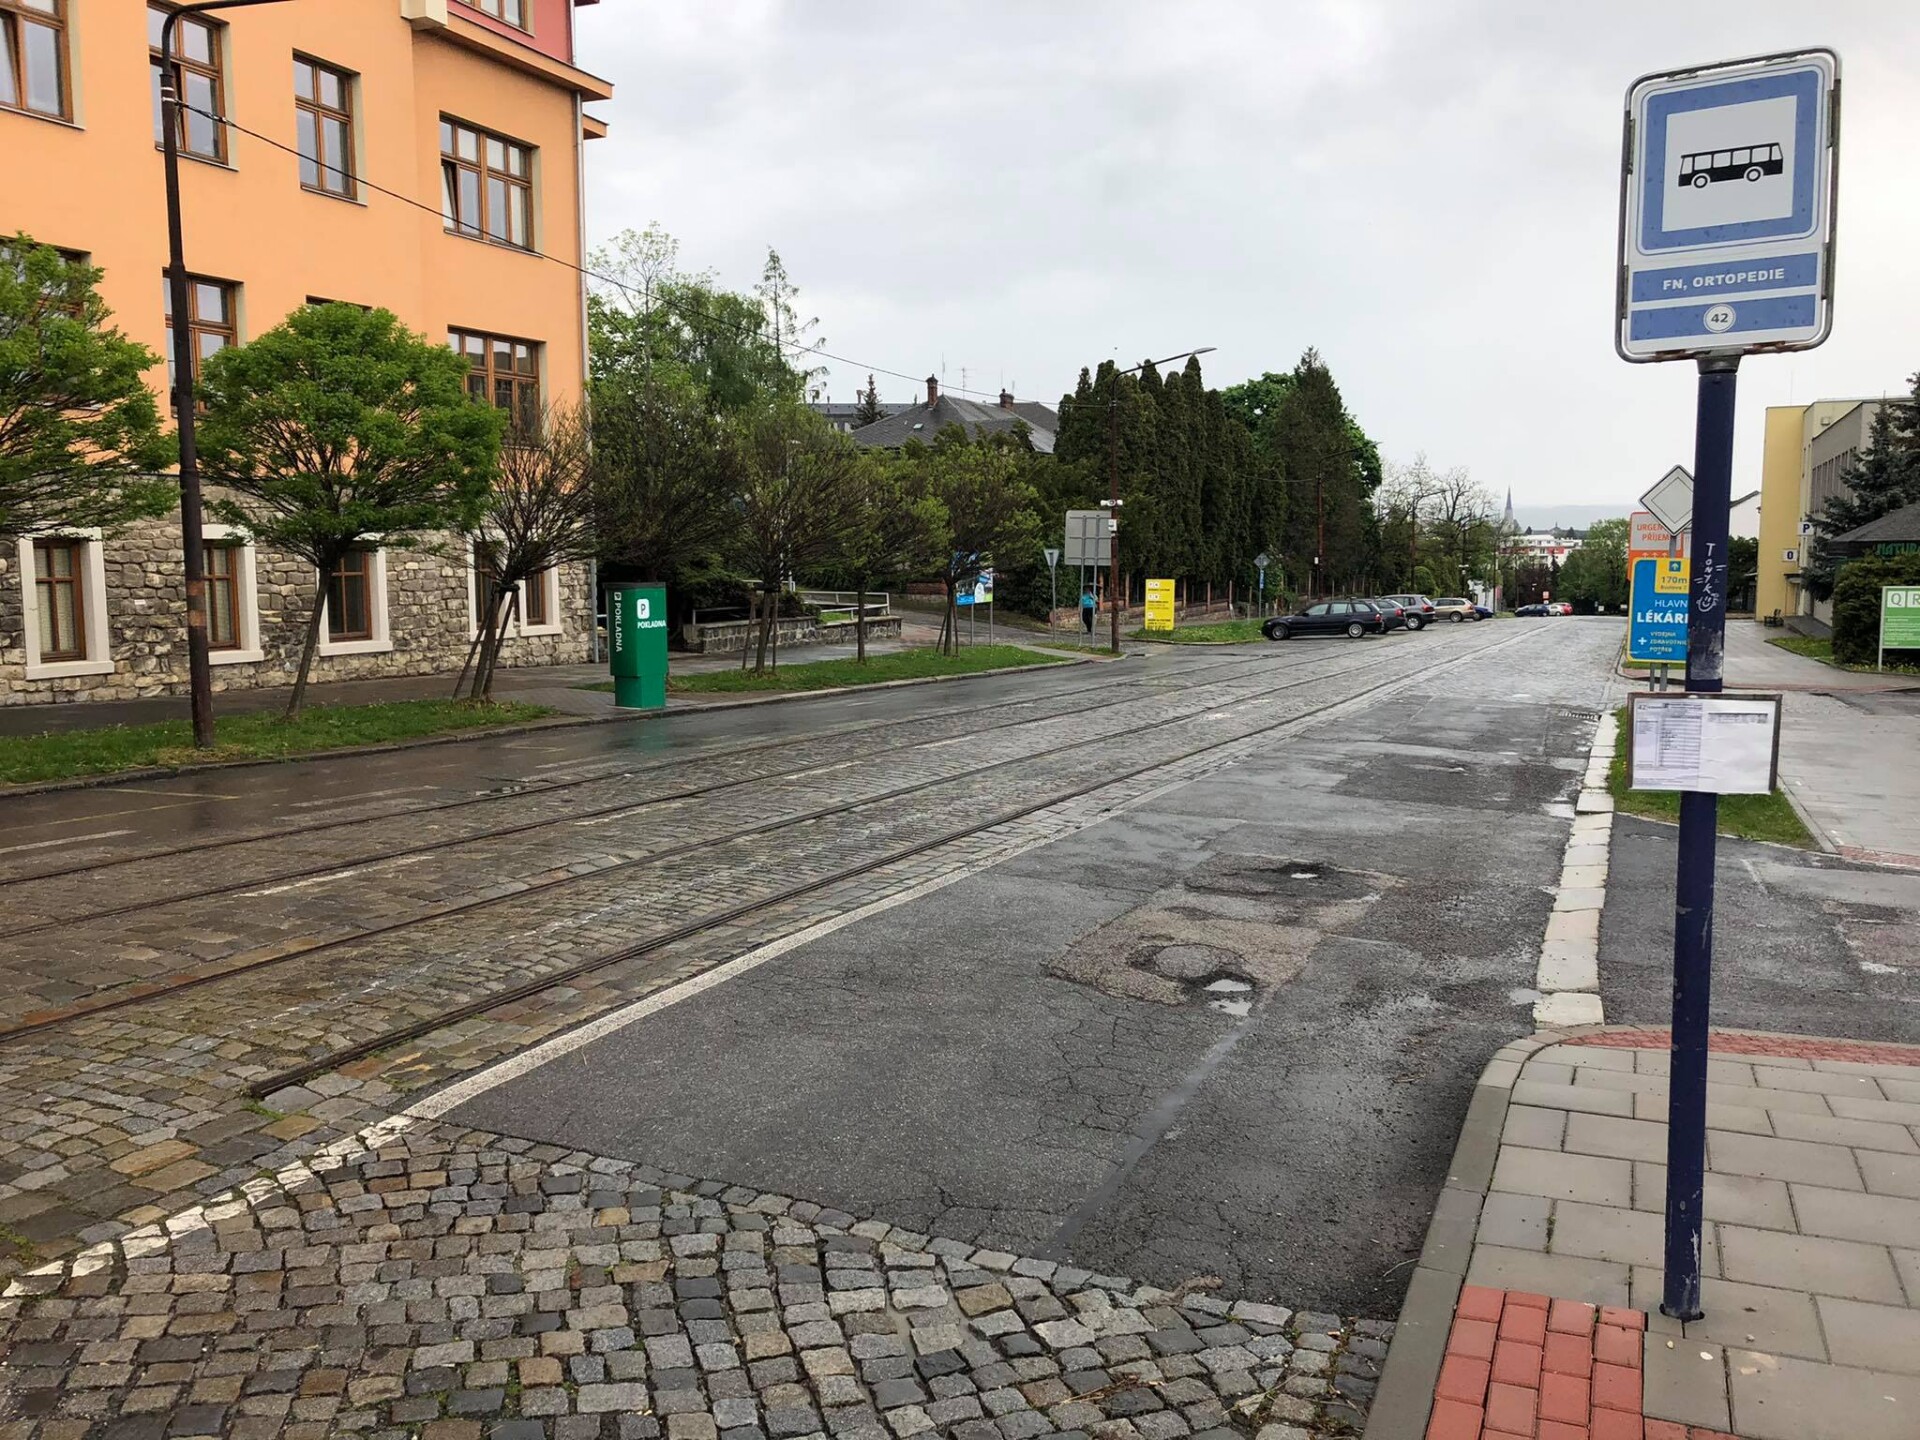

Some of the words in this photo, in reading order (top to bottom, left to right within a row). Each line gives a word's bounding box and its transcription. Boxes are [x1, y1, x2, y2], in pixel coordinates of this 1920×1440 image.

[1662, 279, 1688, 291] FN,
[1692, 268, 1785, 288] ORTOPEDIE
[1710, 312, 1729, 324] 42
[1637, 523, 1664, 531] URGEN
[1802, 523, 1811, 534] P
[1654, 599, 1688, 608] HLAVN
[1890, 592, 1902, 607] Q
[1636, 610, 1688, 624] LÉKÁR
[614, 603, 623, 652] POKLADNA
[637, 620, 666, 629] POKLADNA
